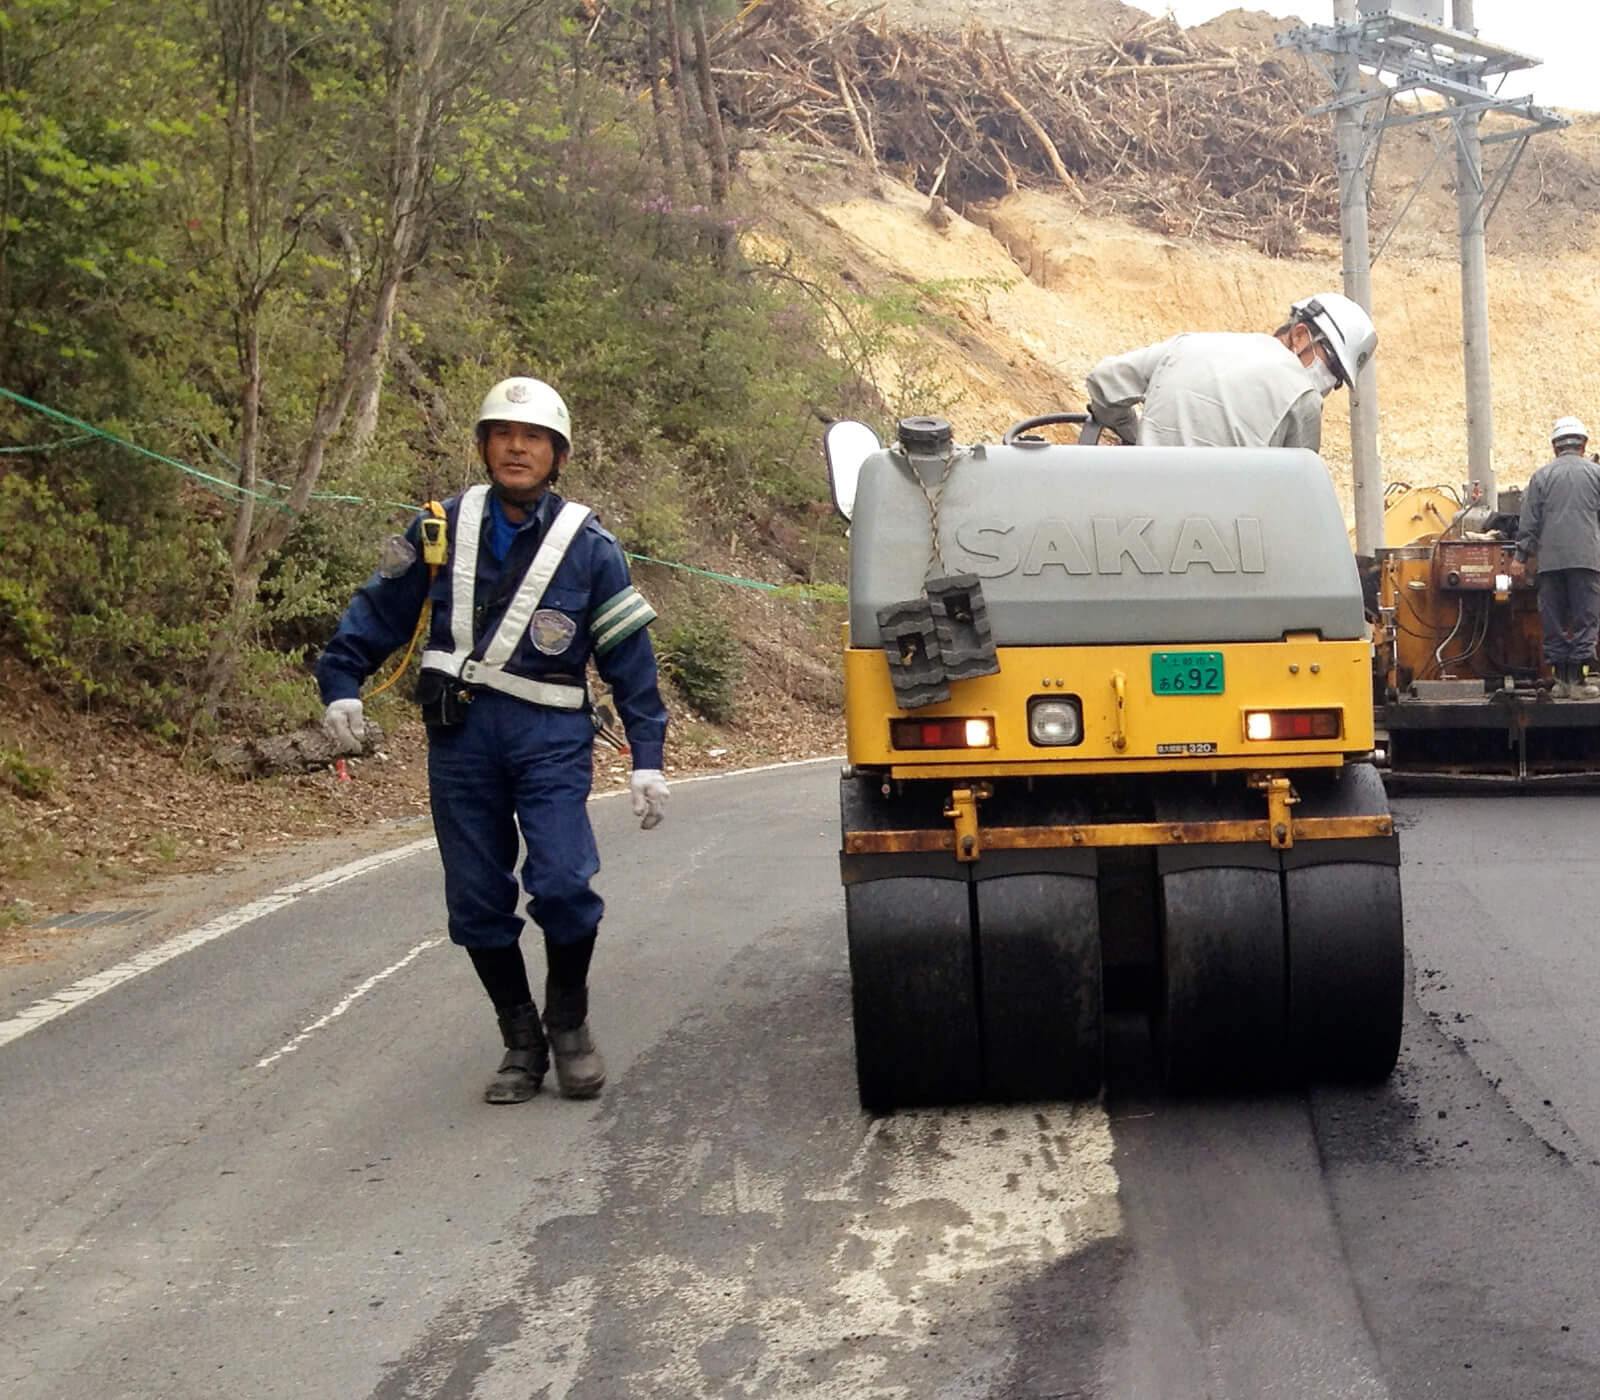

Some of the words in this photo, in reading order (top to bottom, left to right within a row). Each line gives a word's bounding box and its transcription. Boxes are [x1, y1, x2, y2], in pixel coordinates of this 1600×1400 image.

[955, 516, 1265, 578] SAKAI
[1174, 668, 1218, 690] 692
[1188, 743, 1212, 753] 320
